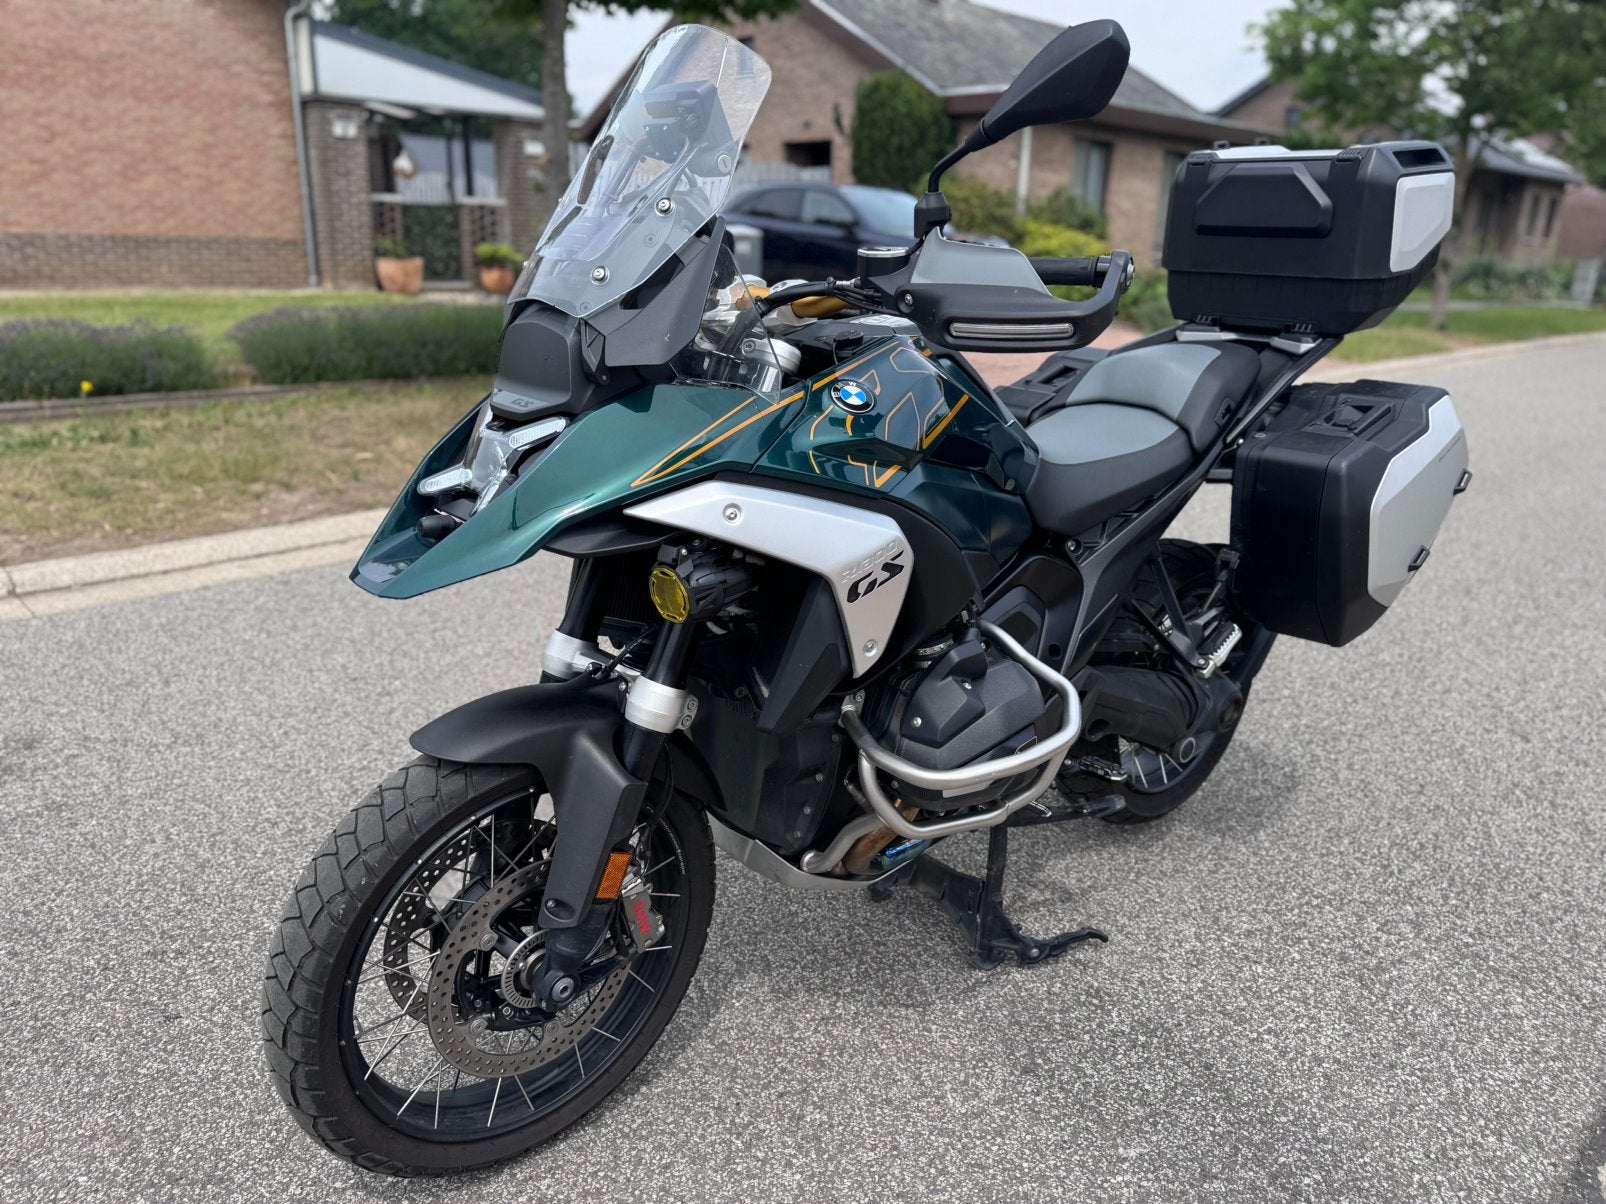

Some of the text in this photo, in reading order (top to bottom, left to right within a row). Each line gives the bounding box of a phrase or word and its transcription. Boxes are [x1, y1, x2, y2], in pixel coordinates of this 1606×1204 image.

[510, 398, 535, 408] GS
[846, 550, 904, 603] GS
[633, 900, 652, 935] BMW
